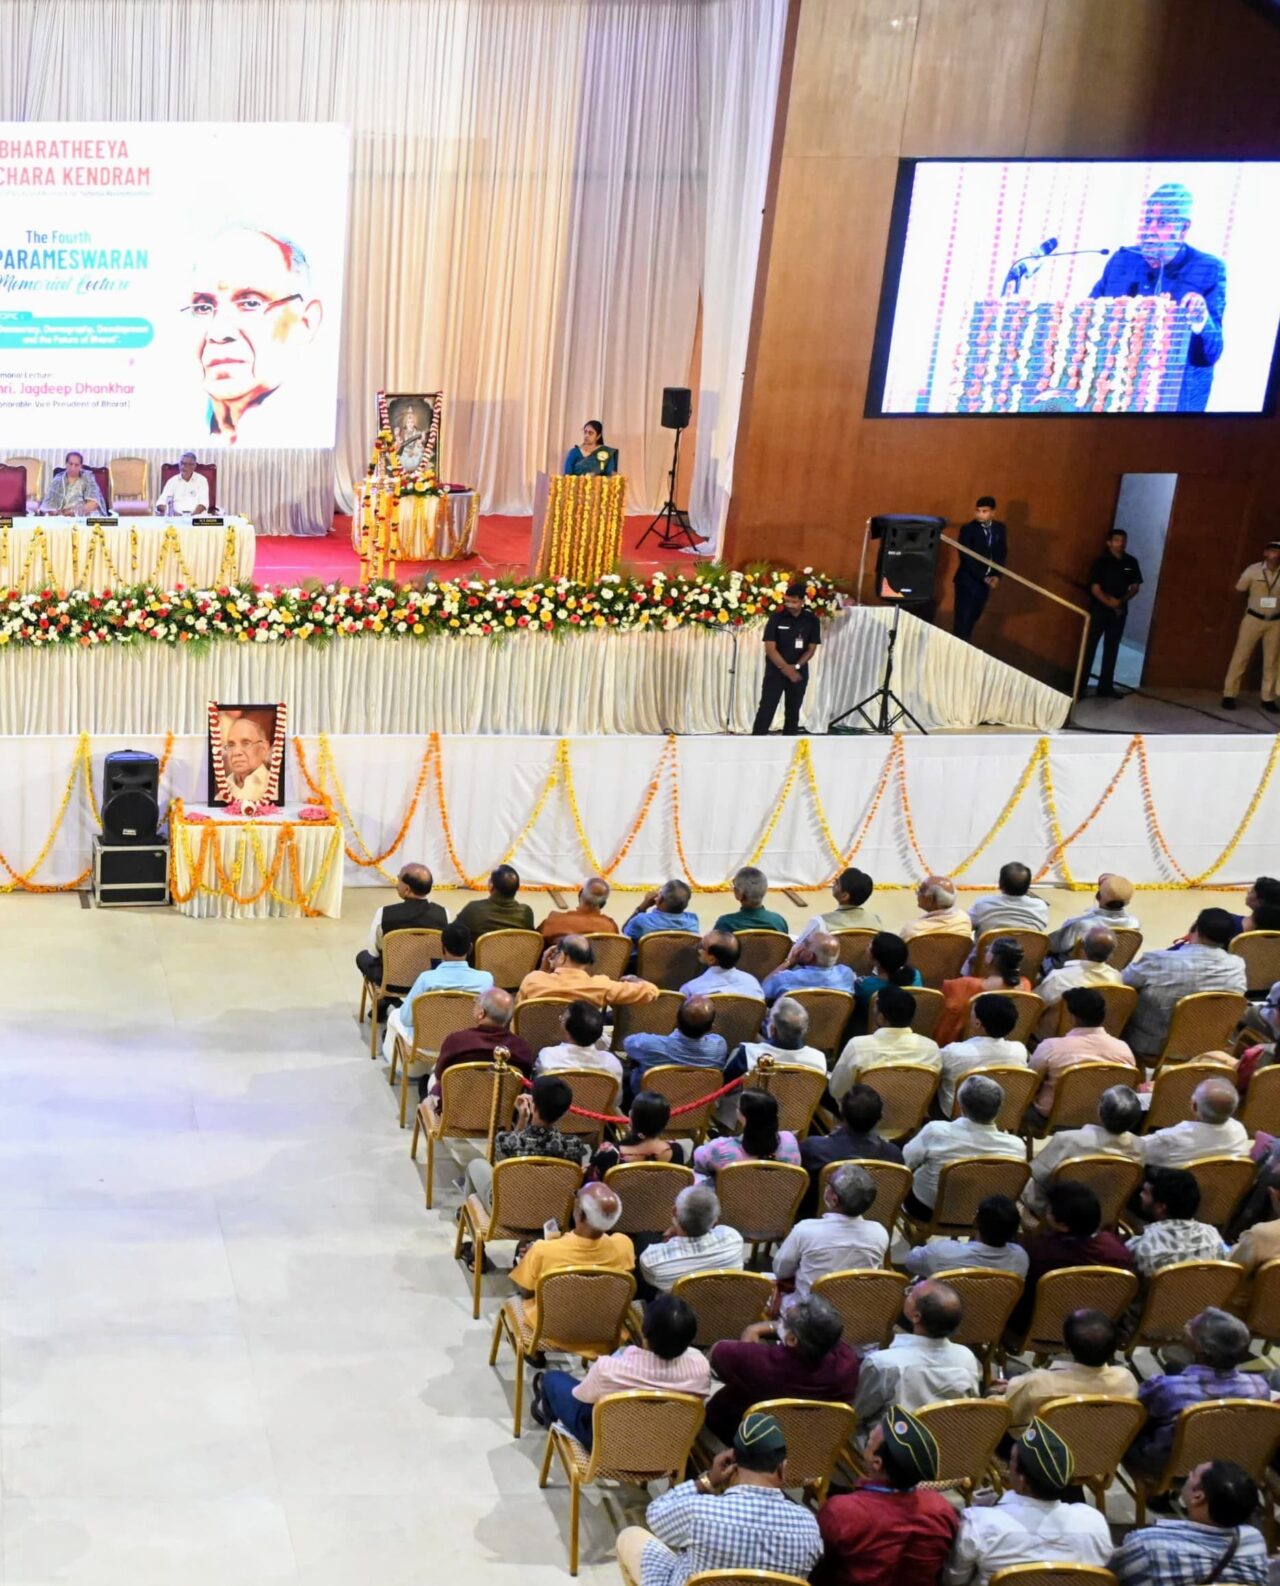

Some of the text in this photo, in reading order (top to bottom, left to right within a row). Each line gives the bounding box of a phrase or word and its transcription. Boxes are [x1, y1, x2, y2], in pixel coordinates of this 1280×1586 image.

[63, 167, 150, 186] KENDRAM
[26, 230, 92, 244] The Fourth
[75, 274, 133, 294] Lecture
[19, 382, 72, 397] Jagdeep
[75, 382, 135, 394] Dhankhar
